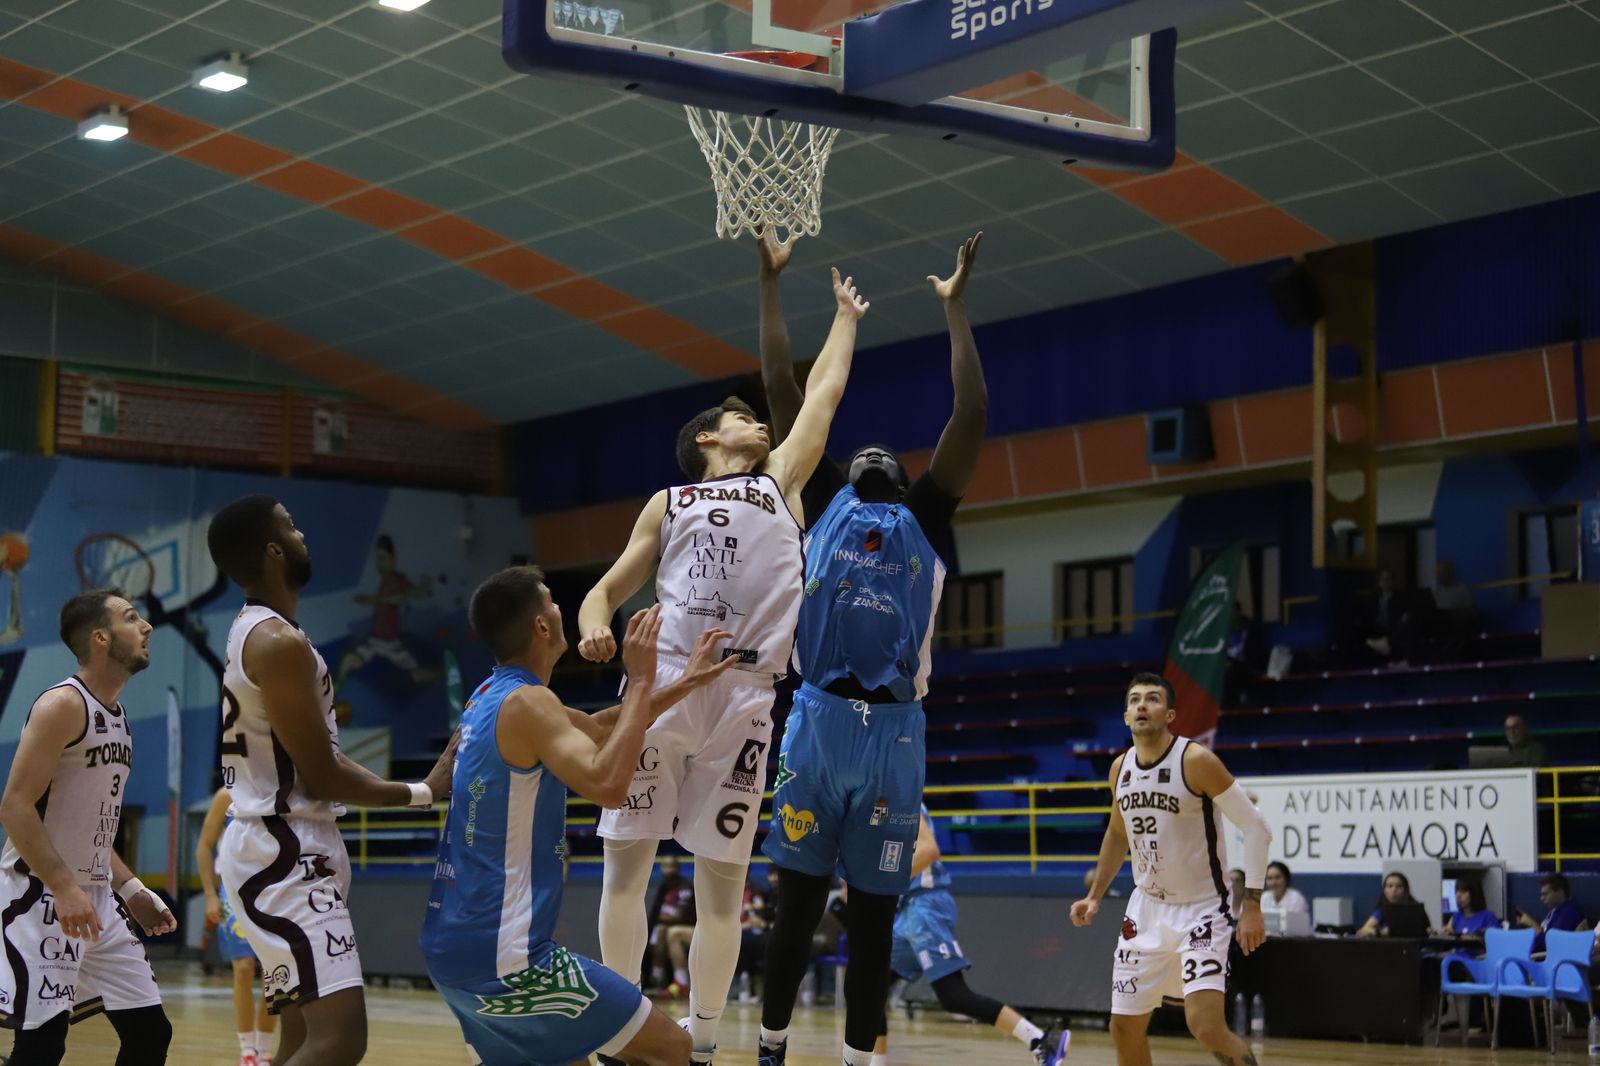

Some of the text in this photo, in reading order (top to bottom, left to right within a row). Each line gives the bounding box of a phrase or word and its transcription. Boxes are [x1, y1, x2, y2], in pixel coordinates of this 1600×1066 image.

[707, 508, 730, 527] 6
[692, 532, 717, 549] LA
[852, 596, 895, 615] ZAMORA
[110, 774, 121, 797] 3
[1283, 785, 1499, 813] AYUNTAMIENTO
[716, 802, 750, 839] 6
[1131, 816, 1157, 834] 32
[1283, 822, 1499, 860] DE ZAMORA
